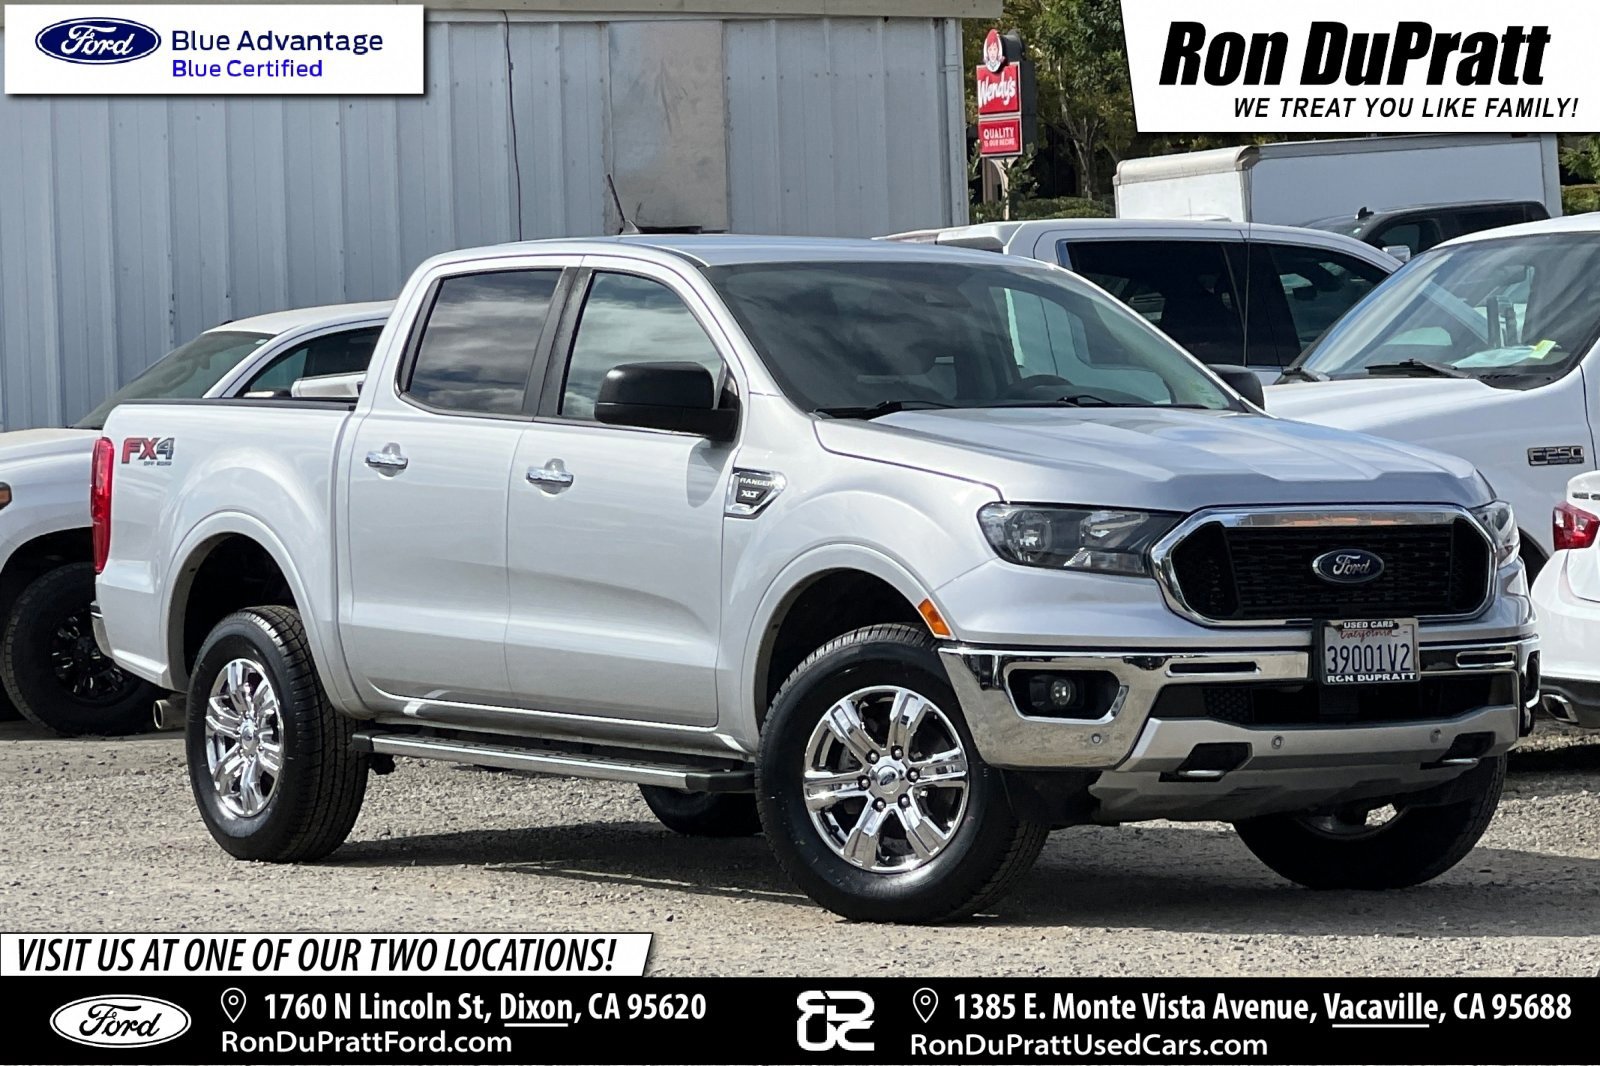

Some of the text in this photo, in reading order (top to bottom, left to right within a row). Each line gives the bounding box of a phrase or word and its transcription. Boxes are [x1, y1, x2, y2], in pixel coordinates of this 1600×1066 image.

[977, 70, 1016, 108] Wendy's
[983, 126, 1015, 140] QUALITY
[121, 437, 175, 464] FX4
[741, 489, 759, 498] XLT
[1332, 554, 1371, 575] Ford
[1343, 620, 1394, 629] USED CARS
[1326, 642, 1411, 674] 39001V2
[1357, 672, 1416, 682] DUPRATT
